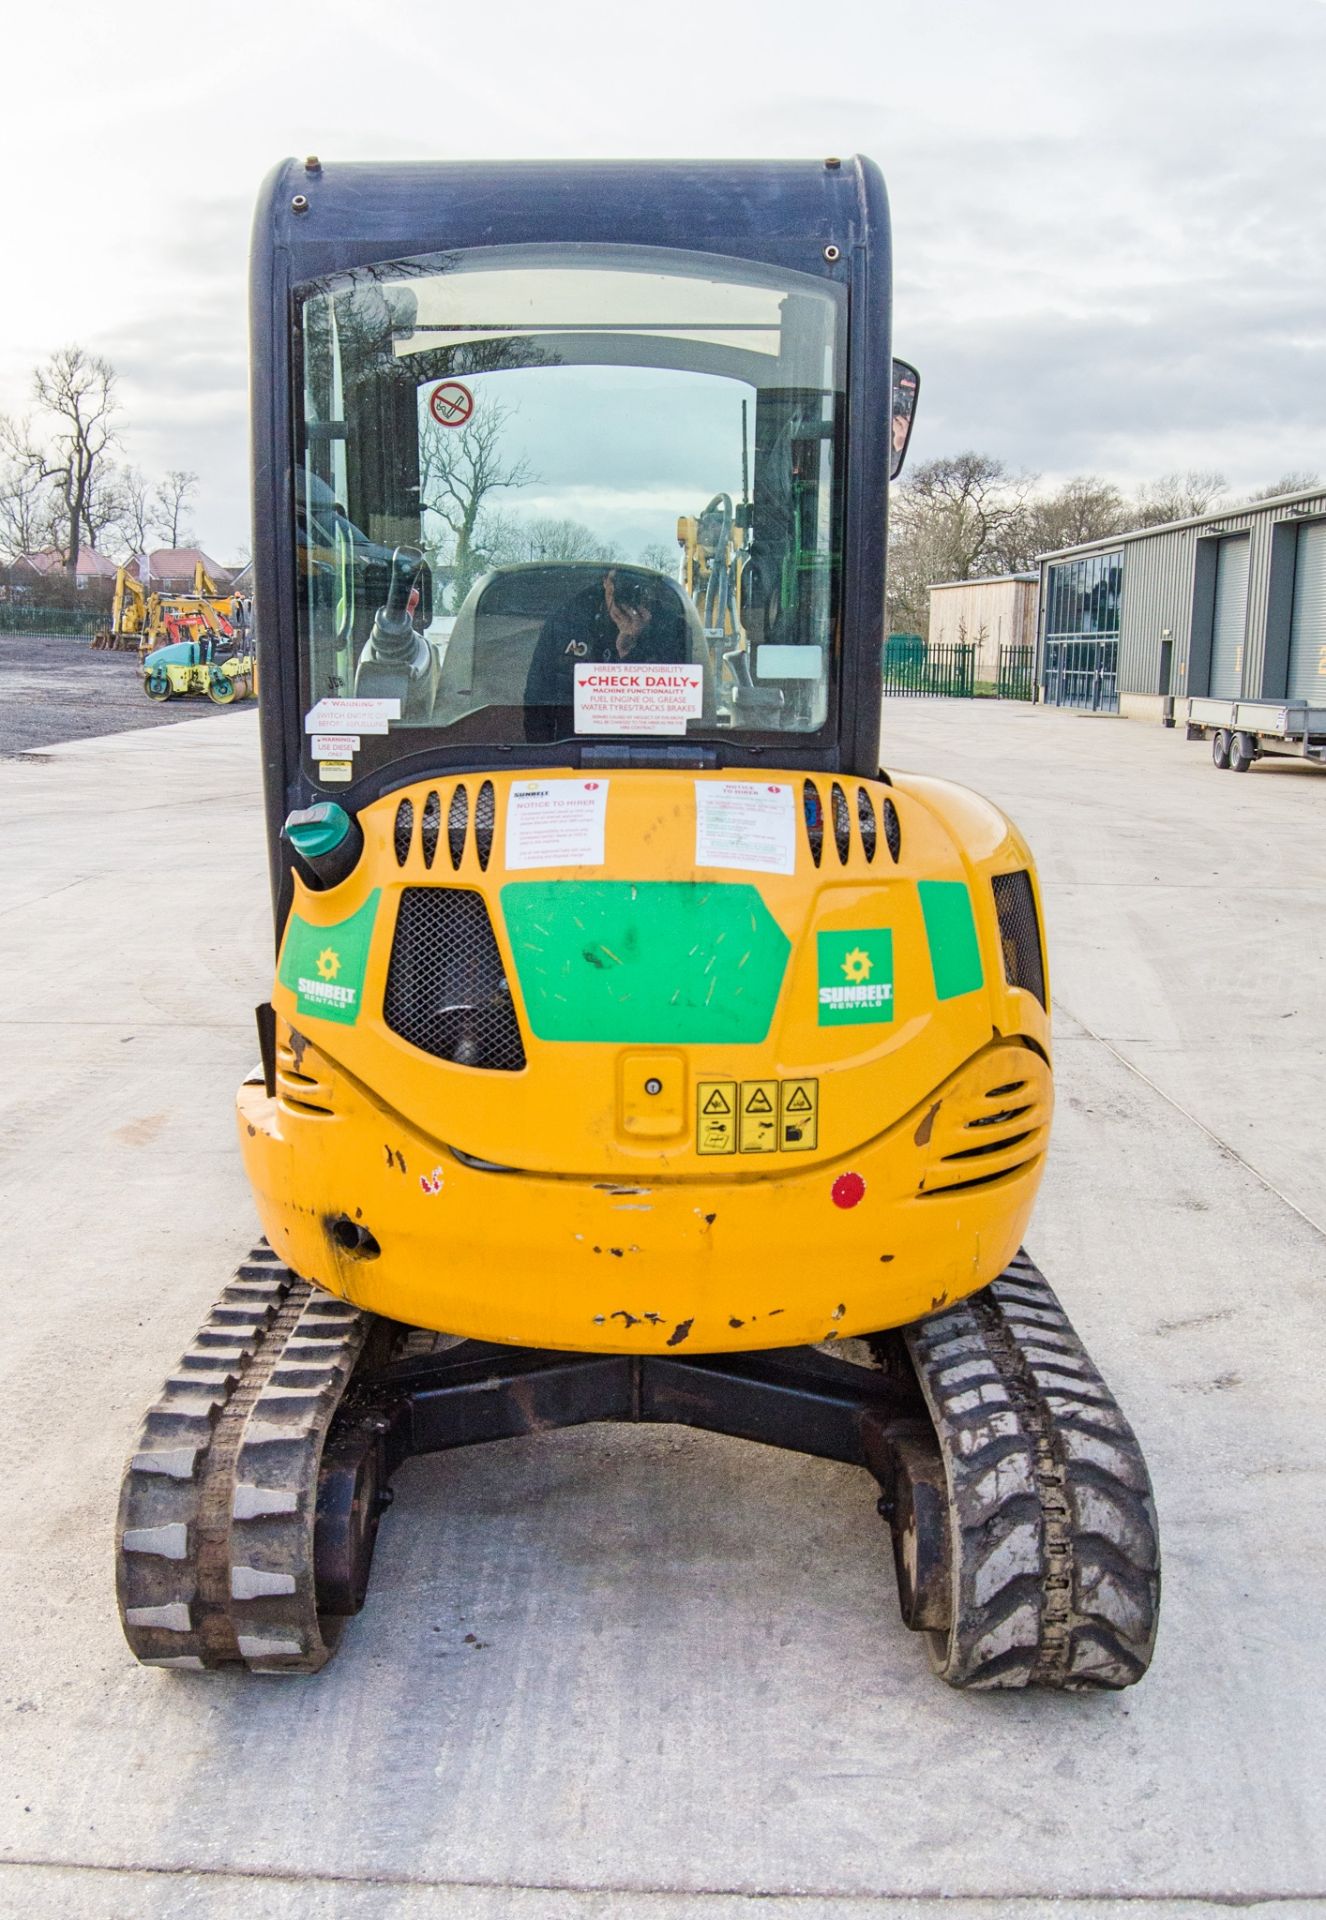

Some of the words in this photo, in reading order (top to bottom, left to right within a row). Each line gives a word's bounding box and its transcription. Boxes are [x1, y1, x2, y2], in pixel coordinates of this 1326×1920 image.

[588, 676, 640, 687] CHECK
[645, 677, 689, 688] DAILY
[610, 696, 640, 704] ENGINE
[658, 696, 687, 704] GREASE
[610, 704, 665, 712] TYRES/TRACKS
[667, 704, 696, 712] BRAKES
[517, 801, 550, 809] NOTICE
[567, 799, 595, 807] HIRER
[298, 977, 356, 1004] SUNBELT
[819, 984, 892, 1004] SUNBELT
[304, 993, 346, 1009] RENTALS
[829, 1000, 882, 1010] RENTALS
